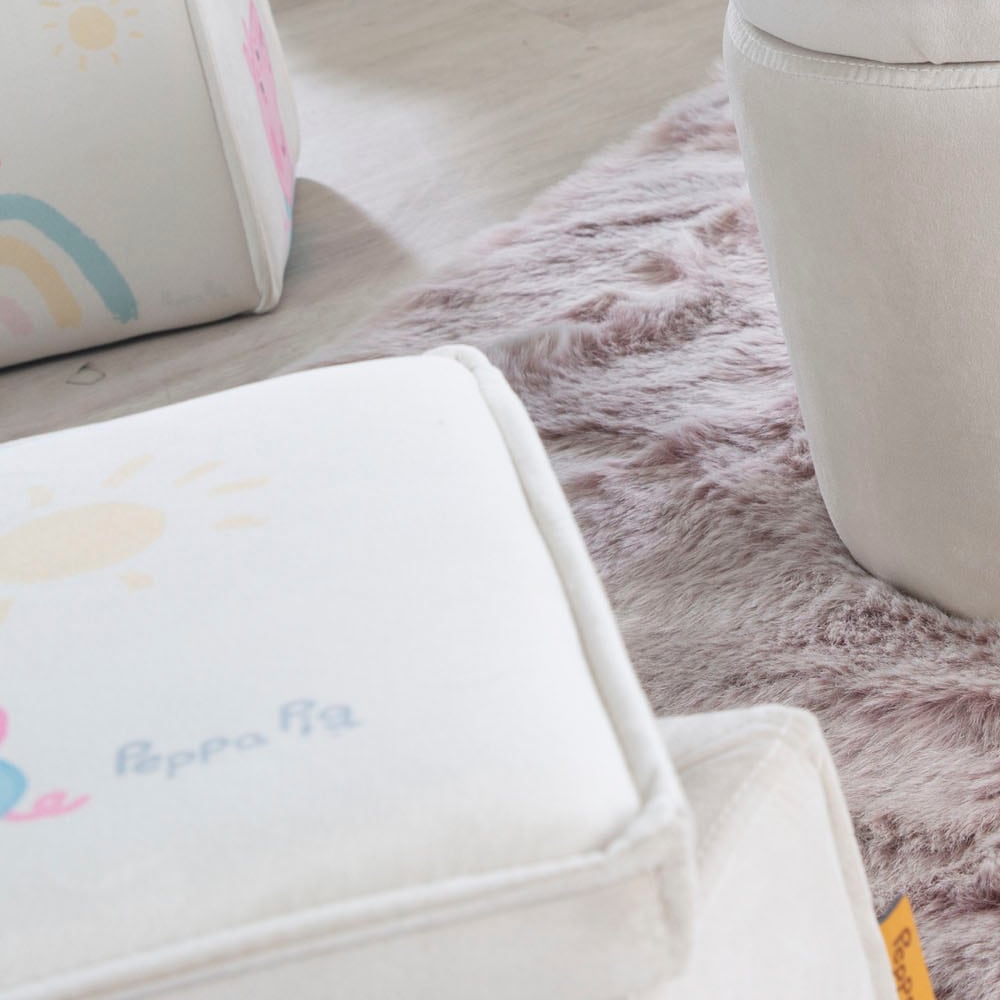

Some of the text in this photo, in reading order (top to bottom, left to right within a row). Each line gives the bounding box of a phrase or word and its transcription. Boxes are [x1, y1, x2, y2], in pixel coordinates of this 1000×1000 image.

[114, 697, 365, 779] Peppa Pig
[892, 926, 915, 1000] Pepp
